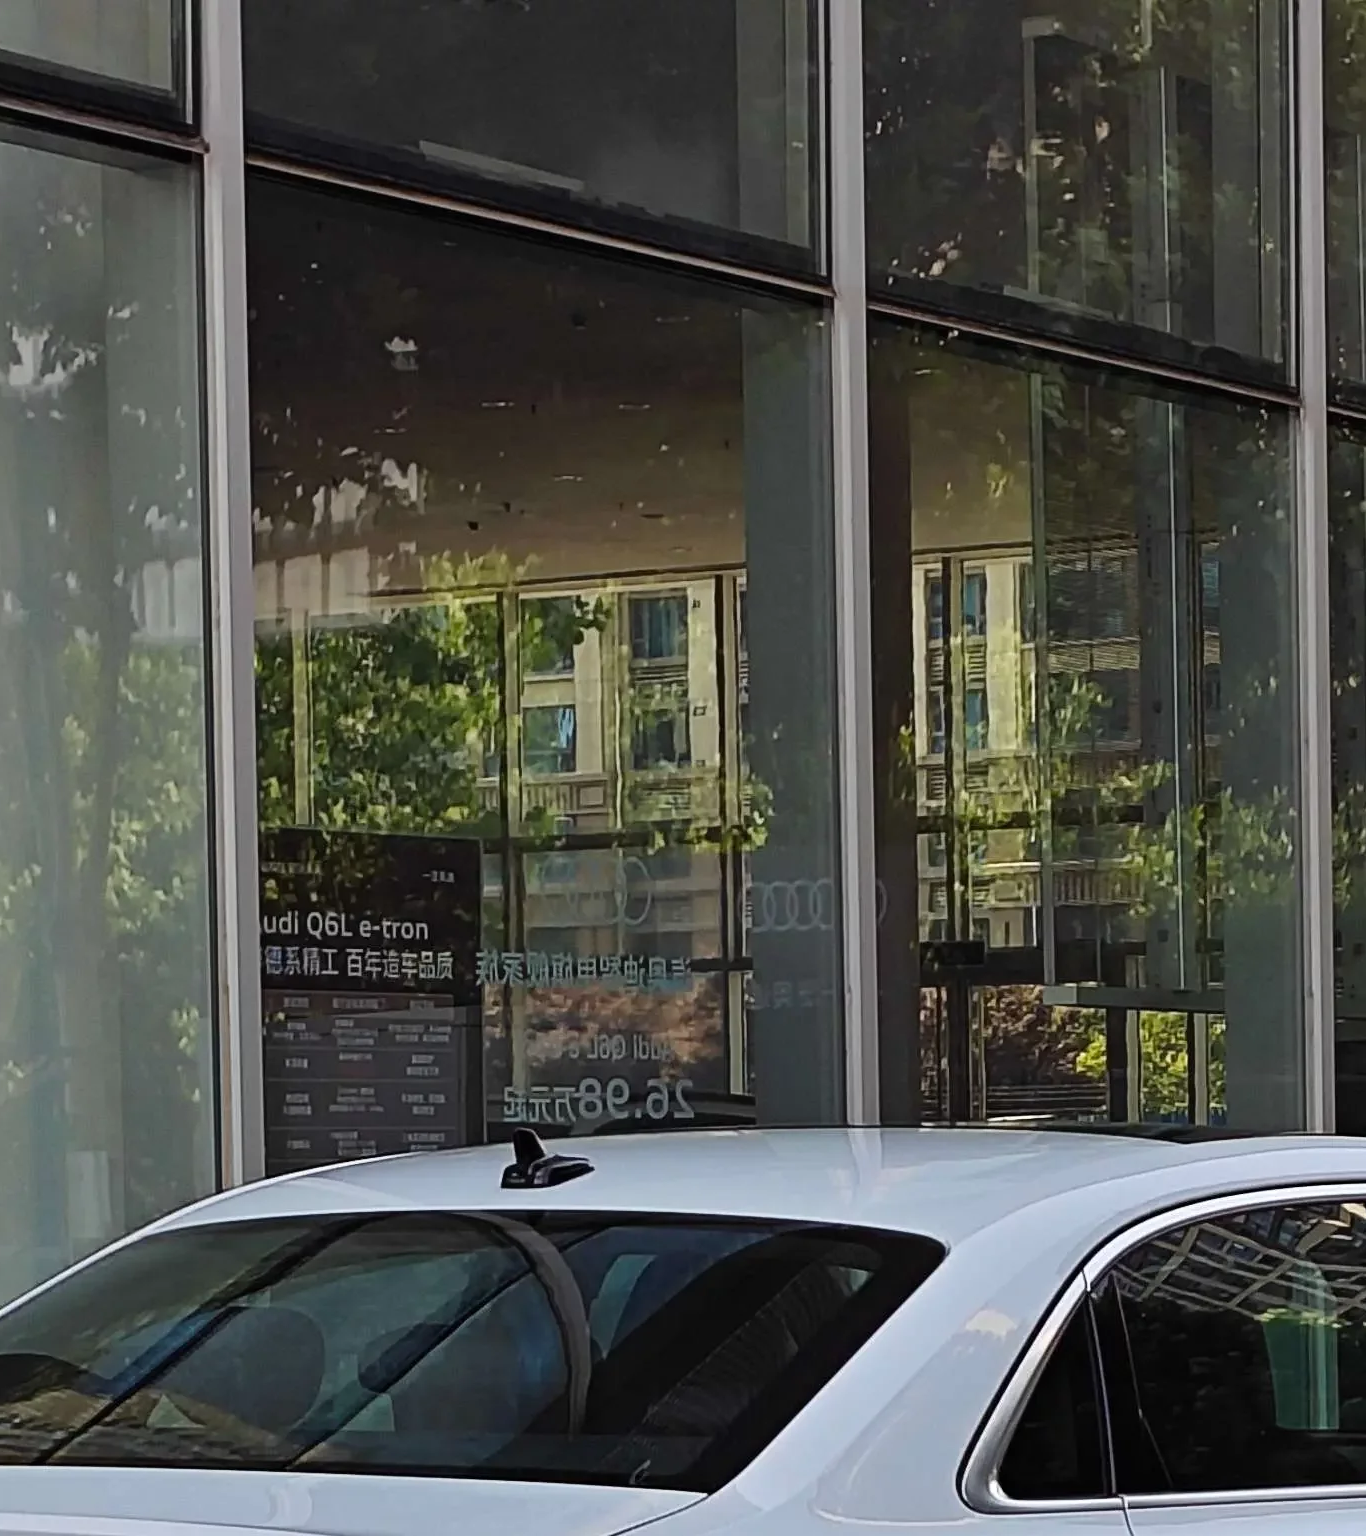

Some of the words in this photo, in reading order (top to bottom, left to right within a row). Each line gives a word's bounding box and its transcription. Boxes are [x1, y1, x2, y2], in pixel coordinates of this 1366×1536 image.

[260, 910, 299, 935] udi
[306, 911, 353, 940] Q6L
[359, 917, 429, 940] e-tron
[261, 945, 339, 976] 德系精工
[345, 948, 453, 981] 百年造车品质
